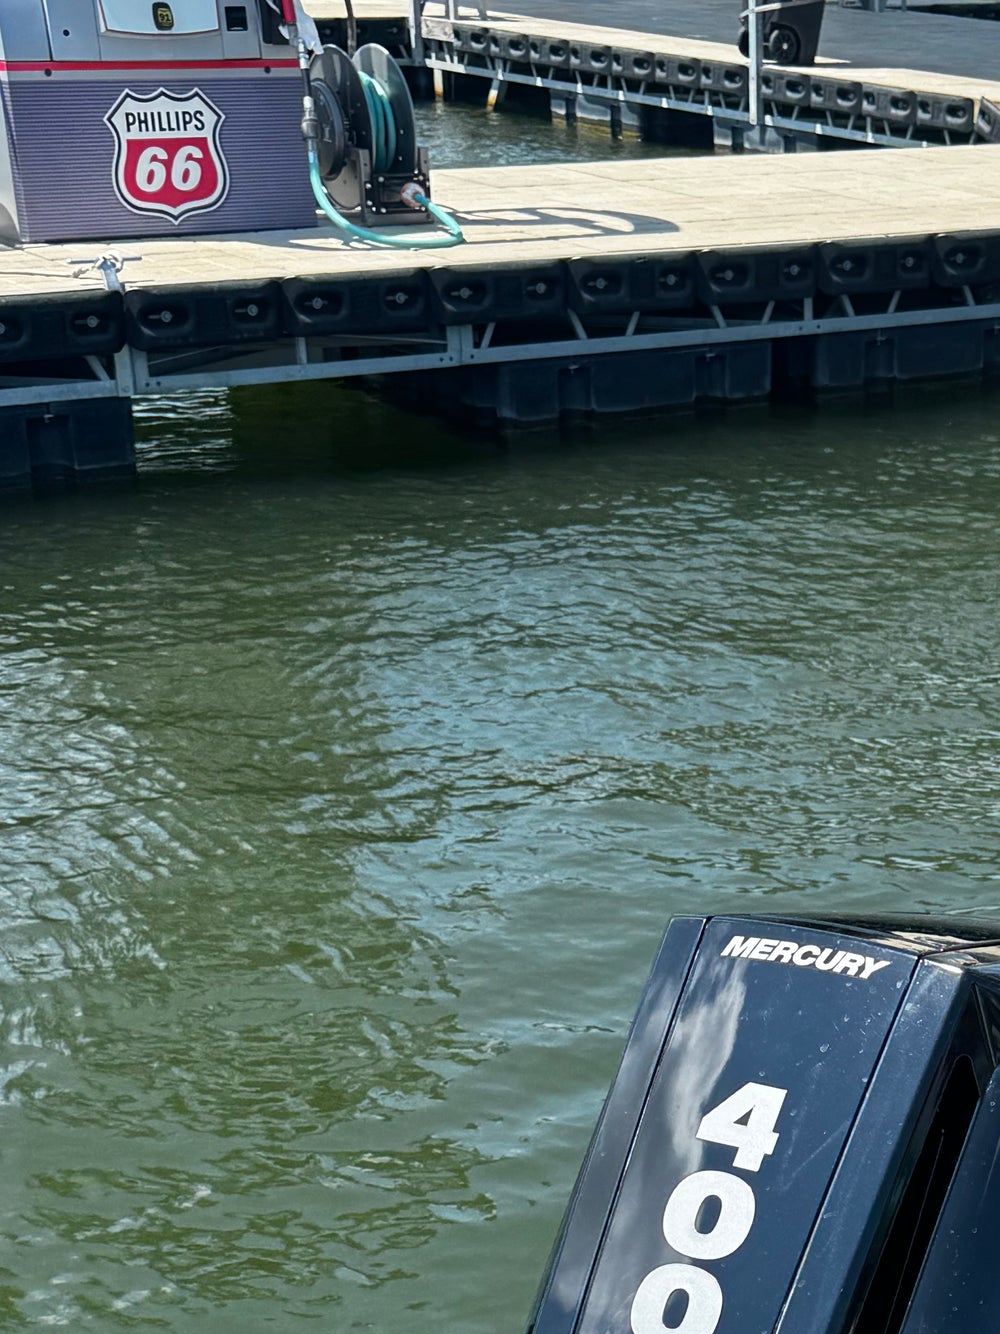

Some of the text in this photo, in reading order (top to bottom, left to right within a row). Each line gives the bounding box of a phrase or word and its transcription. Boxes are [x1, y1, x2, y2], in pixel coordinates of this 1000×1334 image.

[159, 13, 171, 22] 91
[125, 110, 205, 133] PHILLIPS
[135, 145, 204, 193] 66
[720, 935, 891, 980] MERCURY
